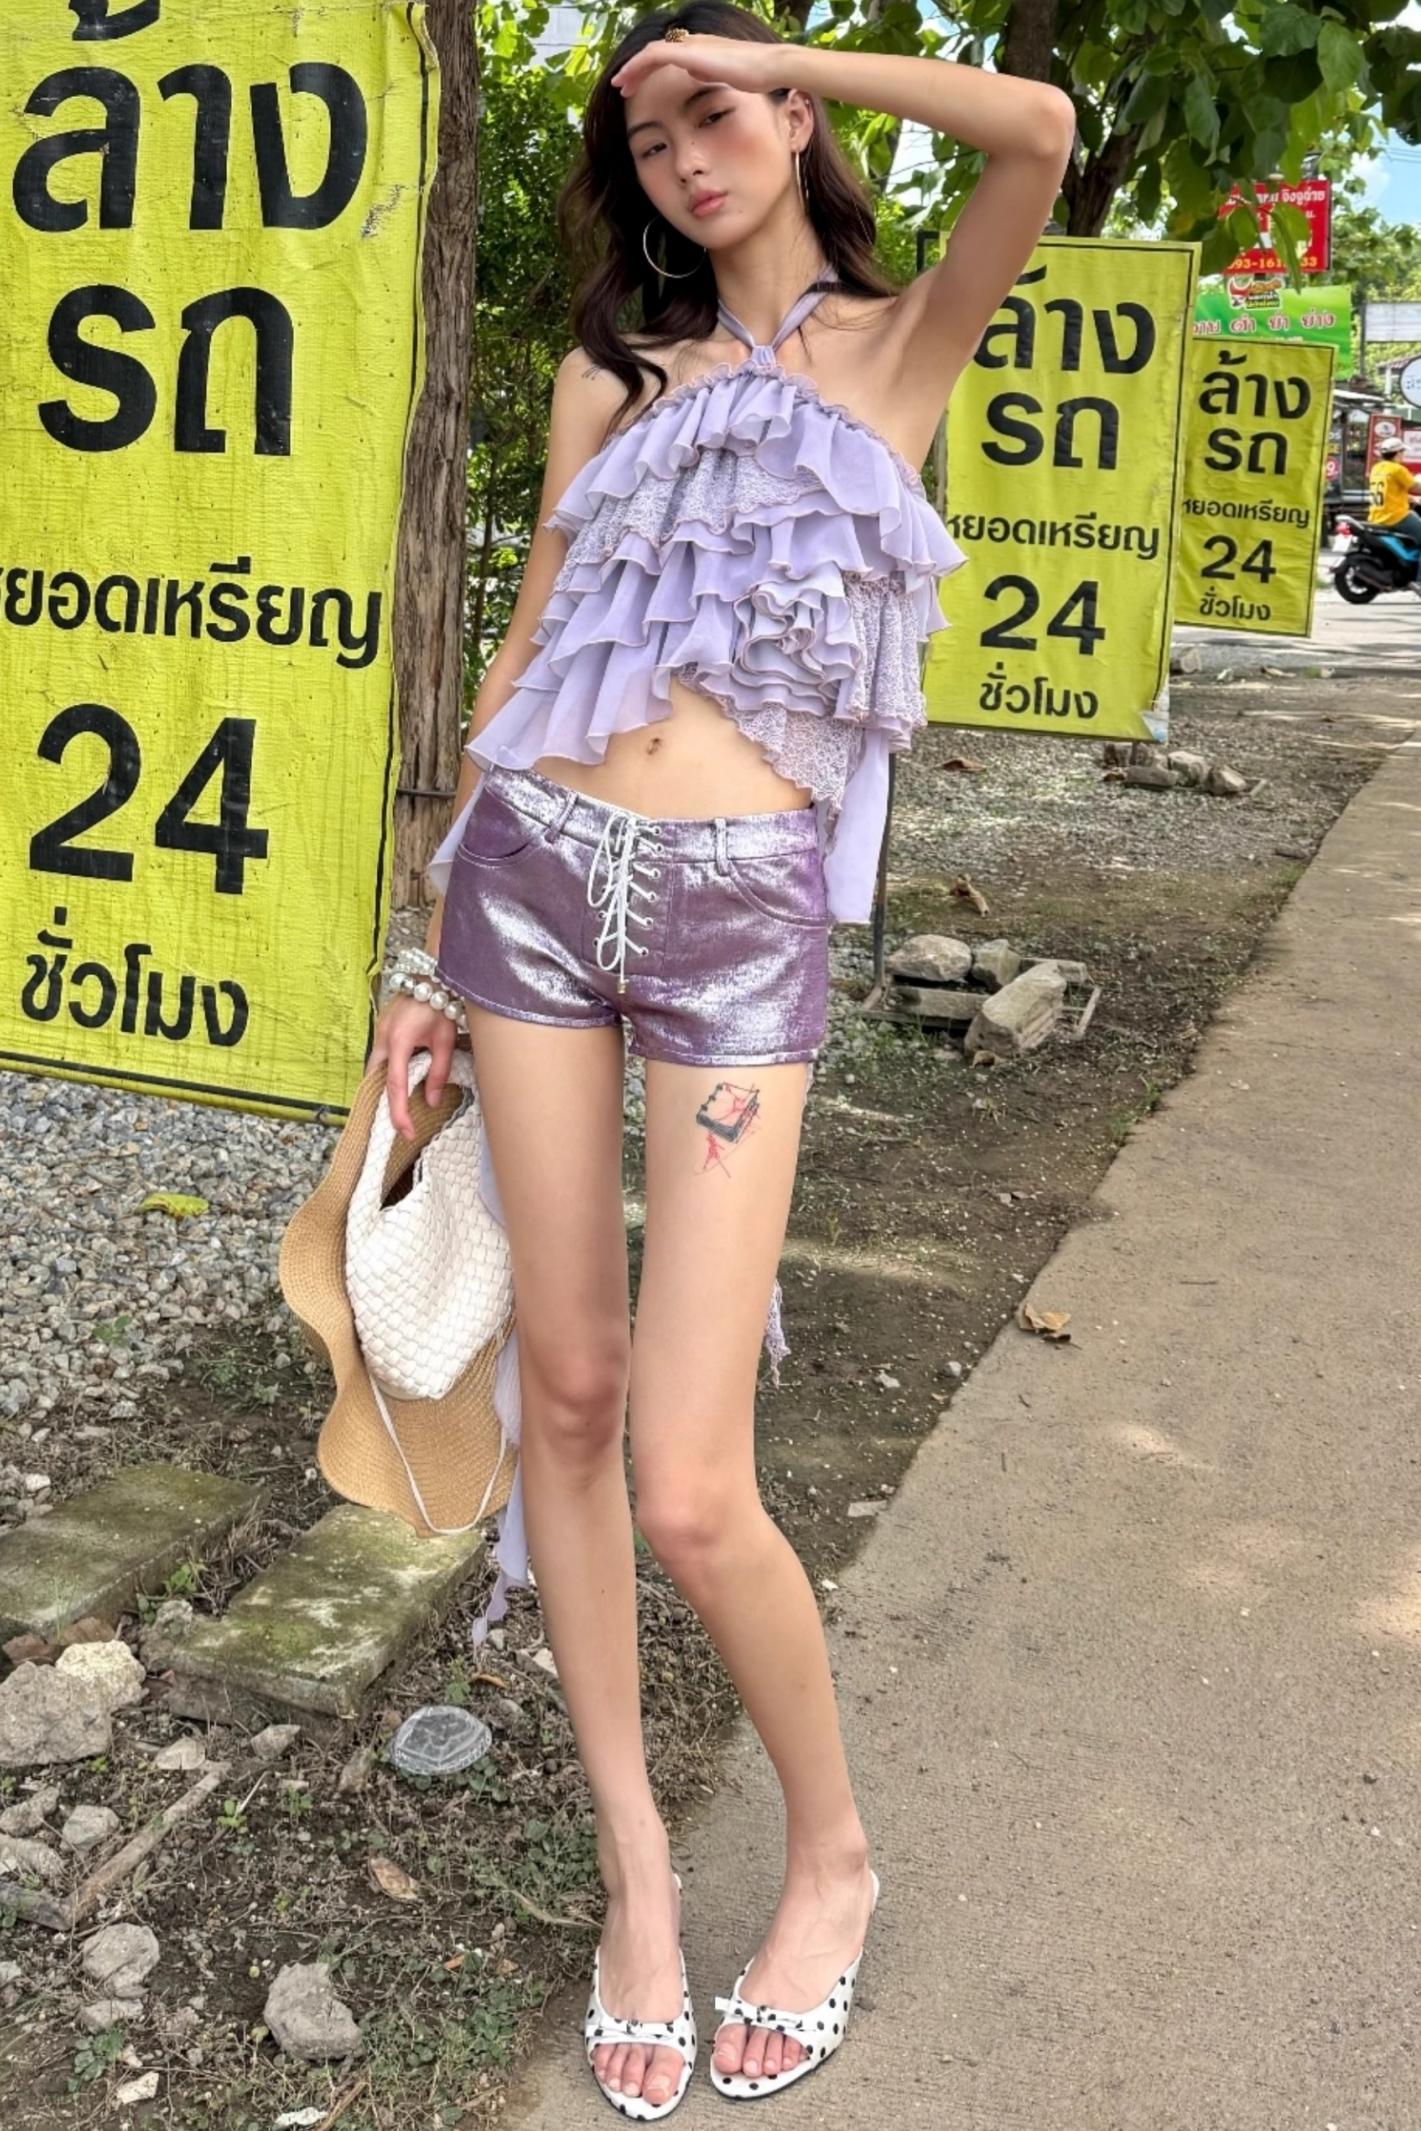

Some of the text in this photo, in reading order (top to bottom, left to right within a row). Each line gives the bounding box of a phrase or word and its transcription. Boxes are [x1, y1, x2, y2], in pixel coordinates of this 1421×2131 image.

[12, 0, 367, 231] ล้าง
[38, 284, 294, 457] รถ
[1198, 350, 1311, 420] ล้าง
[981, 392, 1119, 470] รถ
[1204, 427, 1288, 476] รถ
[1200, 535, 1277, 584] 24
[0, 556, 382, 669] ยอดเหรียญ
[980, 574, 1105, 655] 24
[1199, 586, 1271, 621] ชั่วโมง
[979, 661, 1098, 719] ชั่วโมง
[29, 703, 269, 895] 24
[21, 906, 249, 1047] ชั่วโมง
